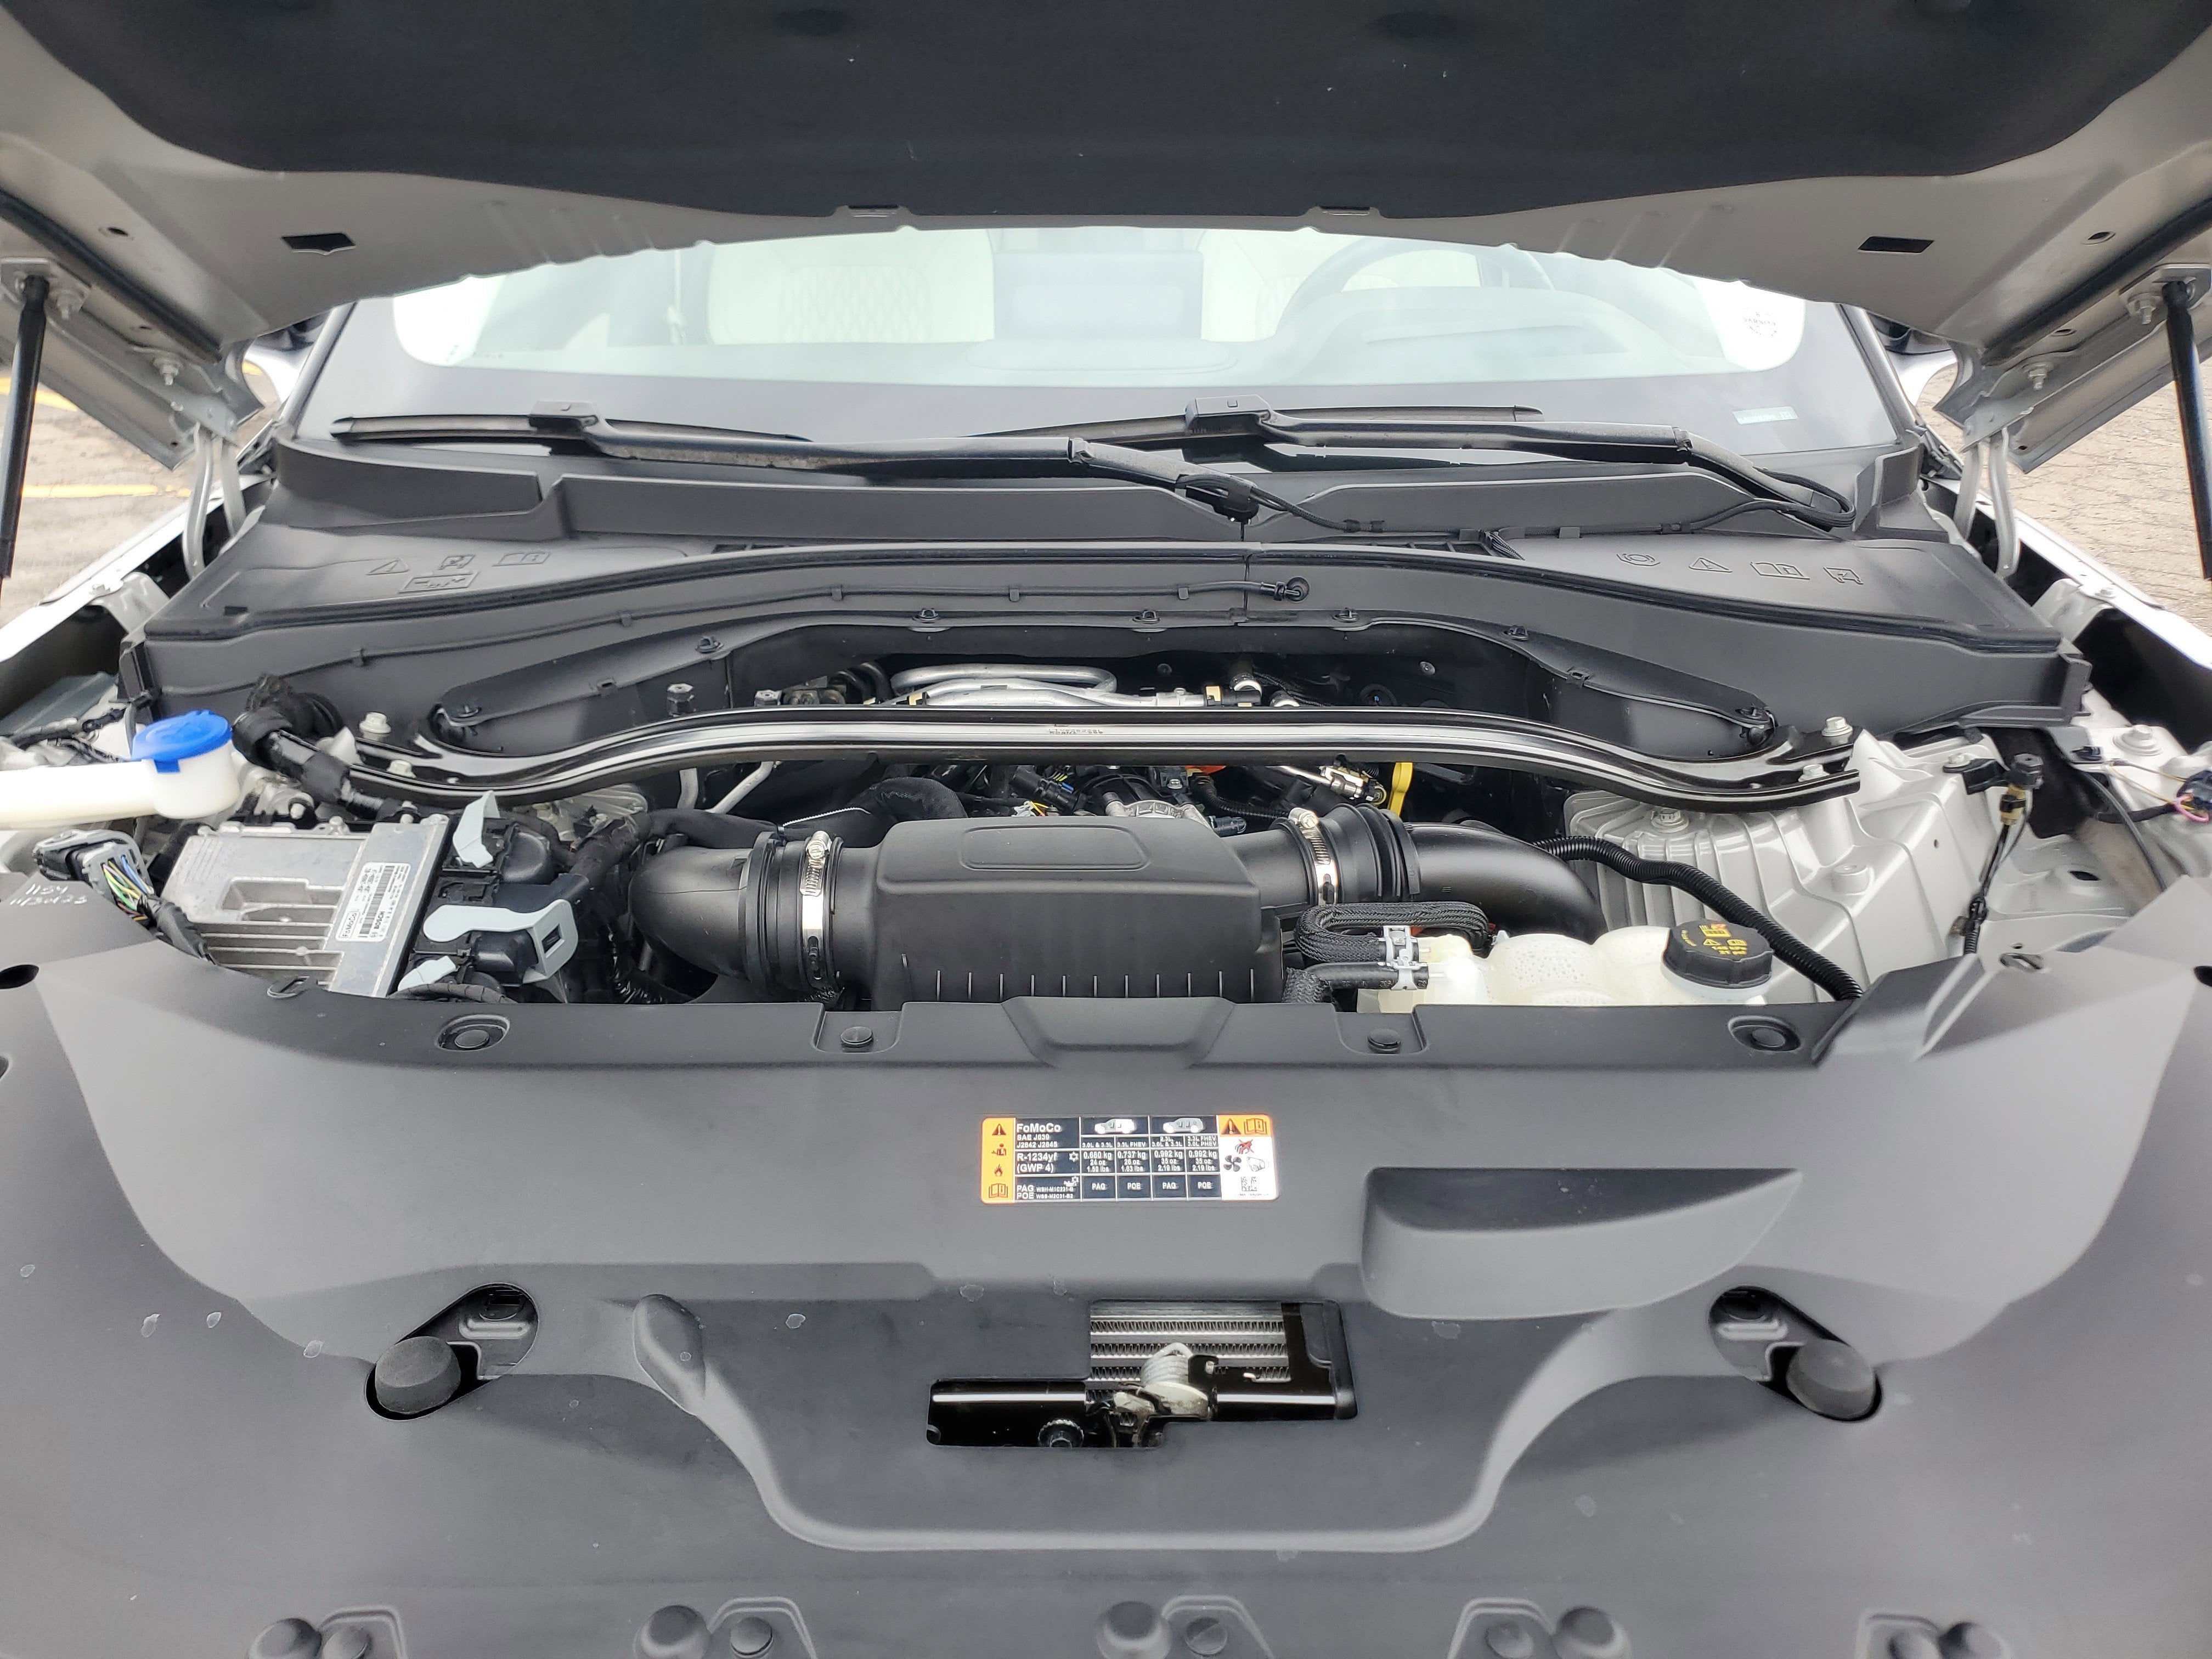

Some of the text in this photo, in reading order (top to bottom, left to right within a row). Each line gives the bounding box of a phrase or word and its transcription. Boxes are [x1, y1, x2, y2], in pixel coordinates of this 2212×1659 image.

[374, 911, 385, 929] BOSCH
[343, 913, 357, 938] FoMoCo
[1017, 1123, 1062, 1132] FoMoCo
[1017, 1153, 1058, 1163] R-1234yf
[1103, 1150, 1112, 1160] kg
[1137, 1150, 1146, 1160] kg
[1174, 1150, 1183, 1160] kg
[1209, 1150, 1217, 1159] kg
[1017, 1163, 1054, 1173] (GWP 4)
